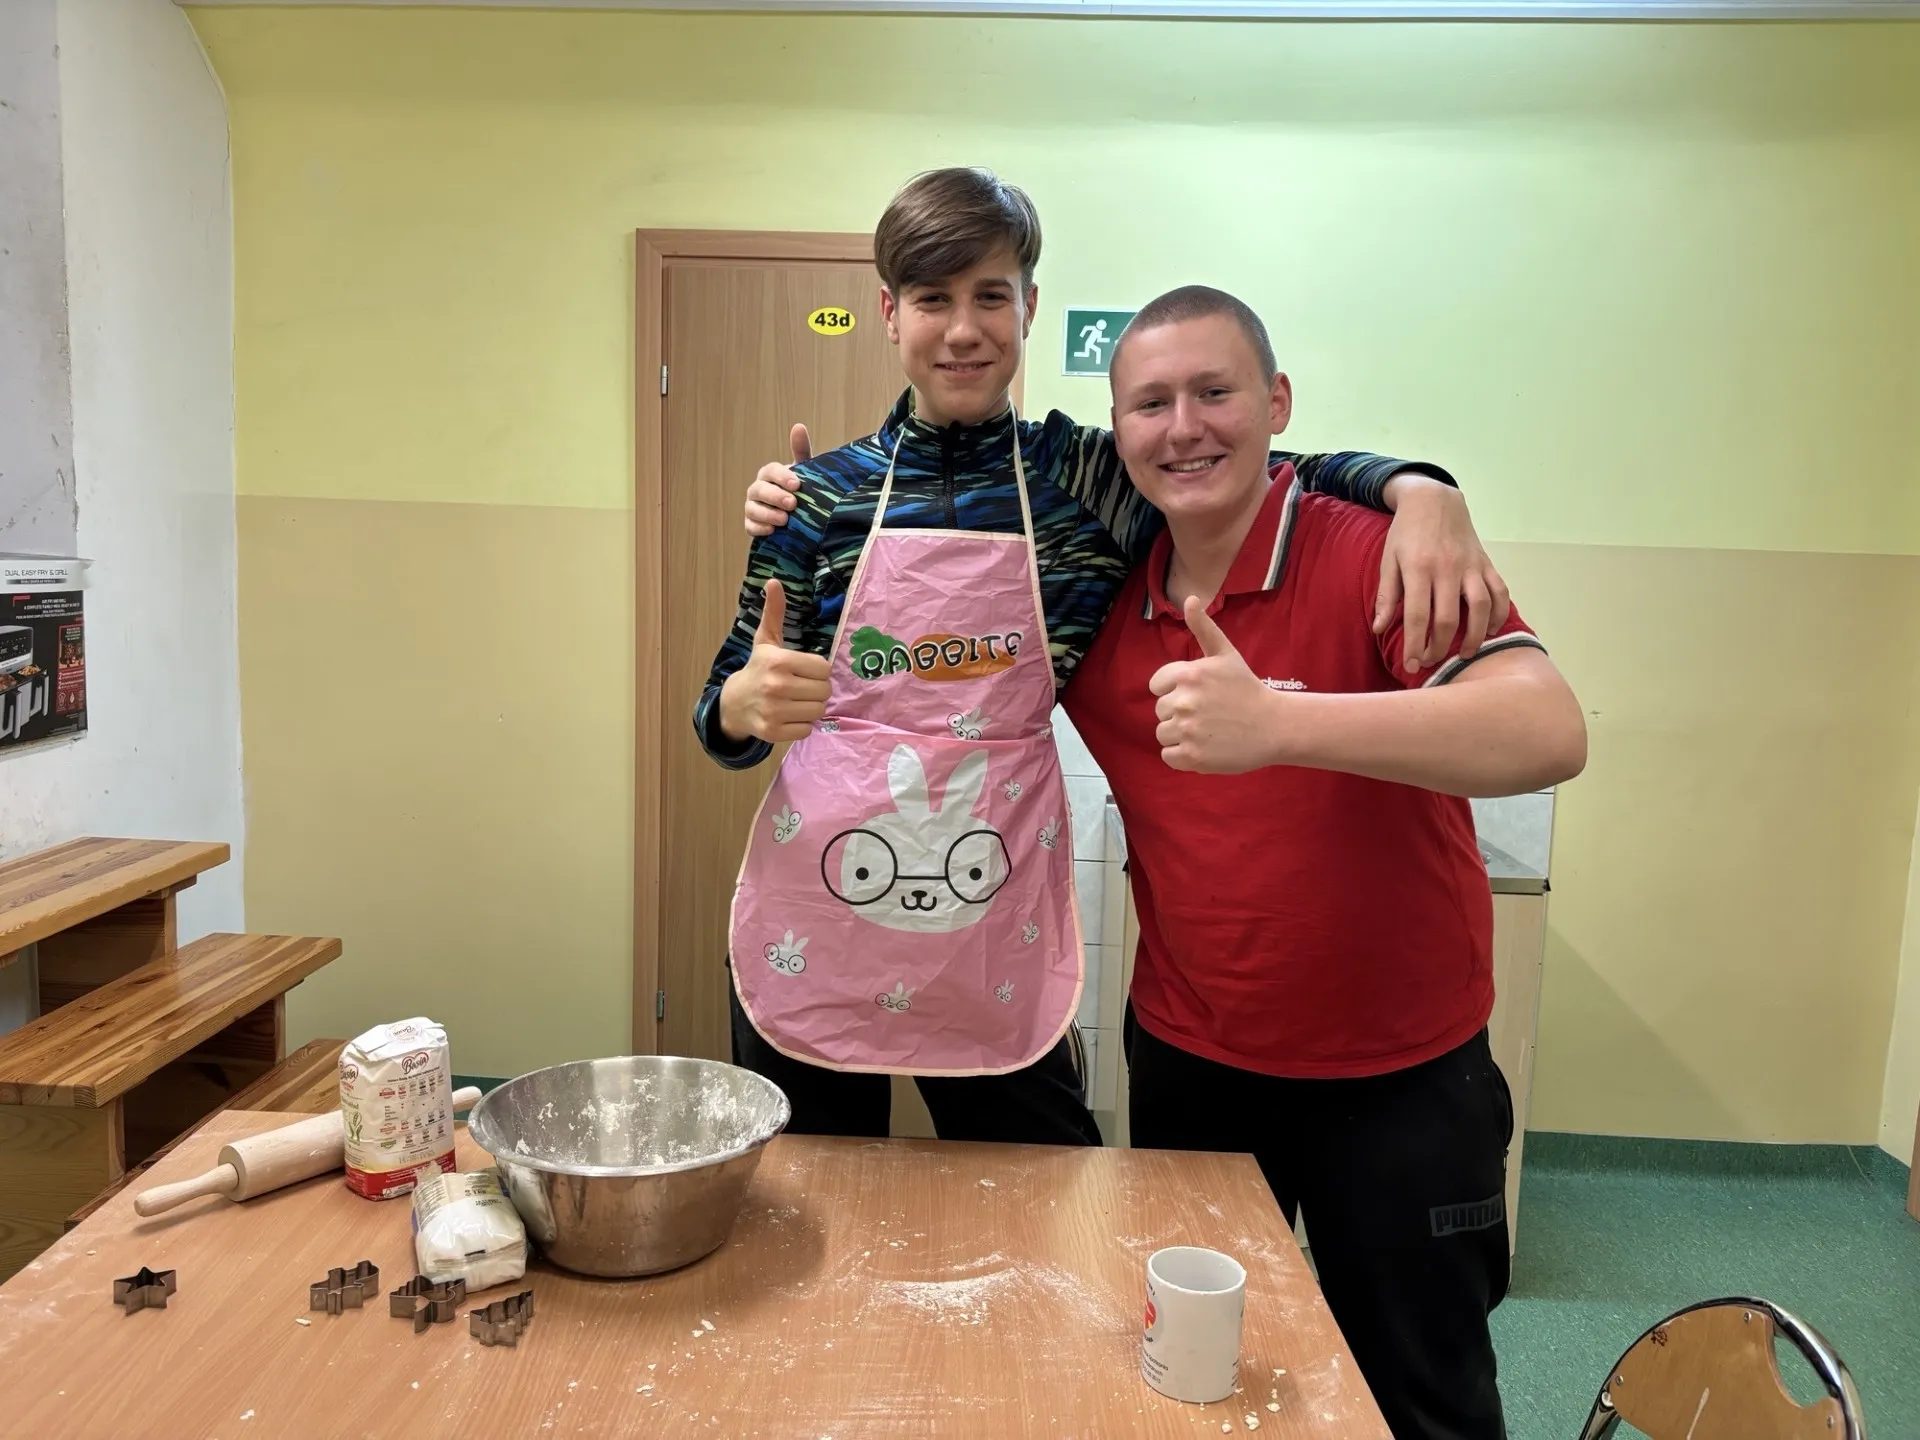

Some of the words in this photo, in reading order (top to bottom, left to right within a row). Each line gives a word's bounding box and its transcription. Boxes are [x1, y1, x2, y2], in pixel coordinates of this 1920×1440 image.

[814, 312, 850, 327] 43d
[4, 569, 20, 577] DUAL
[402, 1055, 427, 1075] Basia
[1429, 1191, 1503, 1236] PUMA
